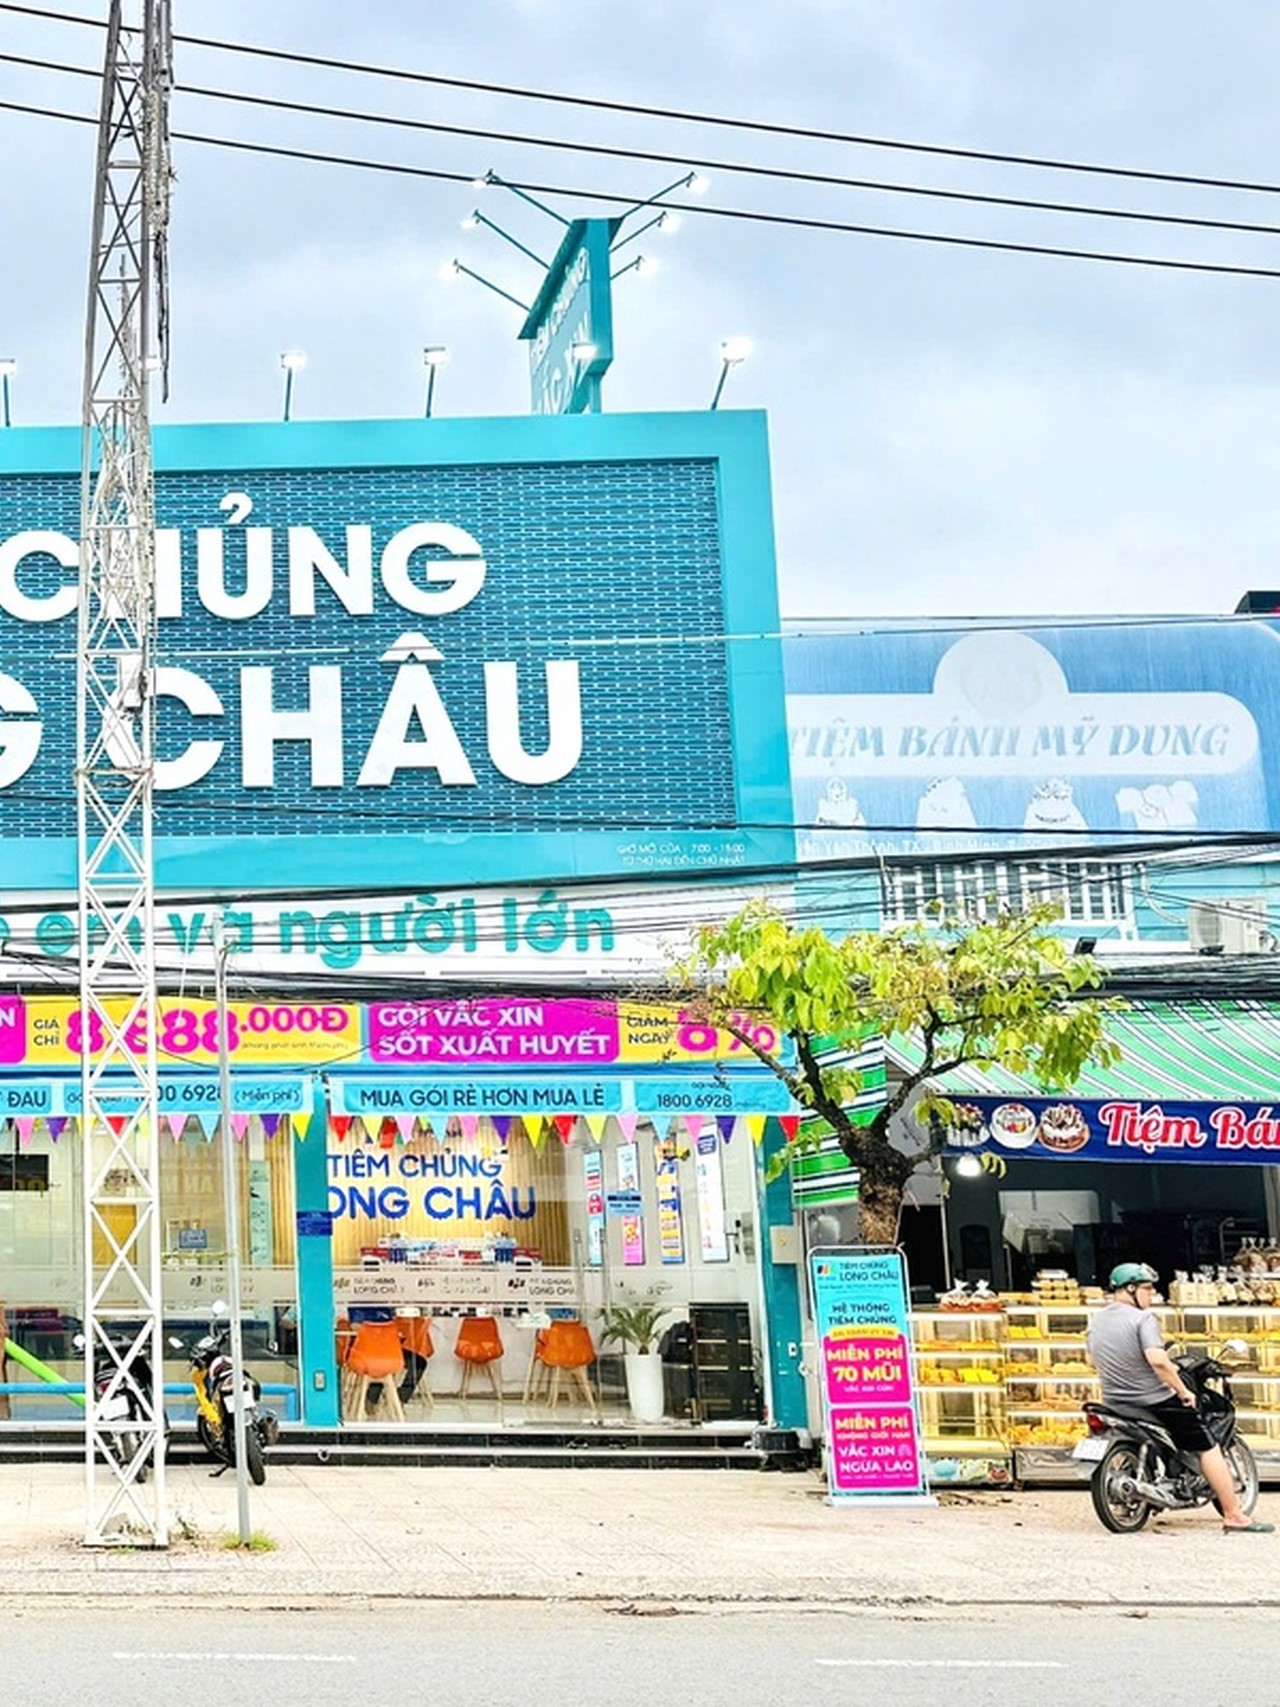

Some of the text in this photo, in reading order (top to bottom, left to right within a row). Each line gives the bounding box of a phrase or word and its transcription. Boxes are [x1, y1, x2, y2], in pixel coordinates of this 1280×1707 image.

[101, 631, 584, 791] CHÂU
[898, 717, 1019, 757] BÁNH
[1032, 715, 1099, 756] MỸ
[1109, 723, 1230, 757] DUNG
[280, 894, 477, 969] người
[504, 890, 615, 954] lớn
[33, 1014, 60, 1030] GIÁ
[378, 1002, 427, 1027] GÓI
[498, 1006, 543, 1027] XIN
[33, 1030, 60, 1046] CHỈ
[379, 1027, 610, 1055] SỐT XUẤT HUYẾT
[7, 1090, 47, 1108] ĐAU
[361, 1083, 604, 1107] MUA GÓI RẺ HƠN MUA LẺ
[657, 1094, 691, 1108] 1800
[695, 1094, 732, 1108] 6928
[1098, 1102, 1207, 1153] Tiệm
[328, 1148, 502, 1178] TIÊM CHỦNG
[328, 1179, 537, 1220] ONG CHÂU
[839, 1271, 868, 1281] LONG
[871, 1269, 899, 1280] CHÂU
[851, 1301, 890, 1313] THỐNG
[827, 1313, 897, 1325] TIÊM CHỦNG
[827, 1343, 904, 1361] MIỄN PHÍ
[832, 1361, 901, 1383] 70 MŨI
[835, 1412, 909, 1430] MIỄN PHÍ
[871, 1446, 896, 1457] XIN
[840, 1459, 914, 1474] NGỪA LAO
